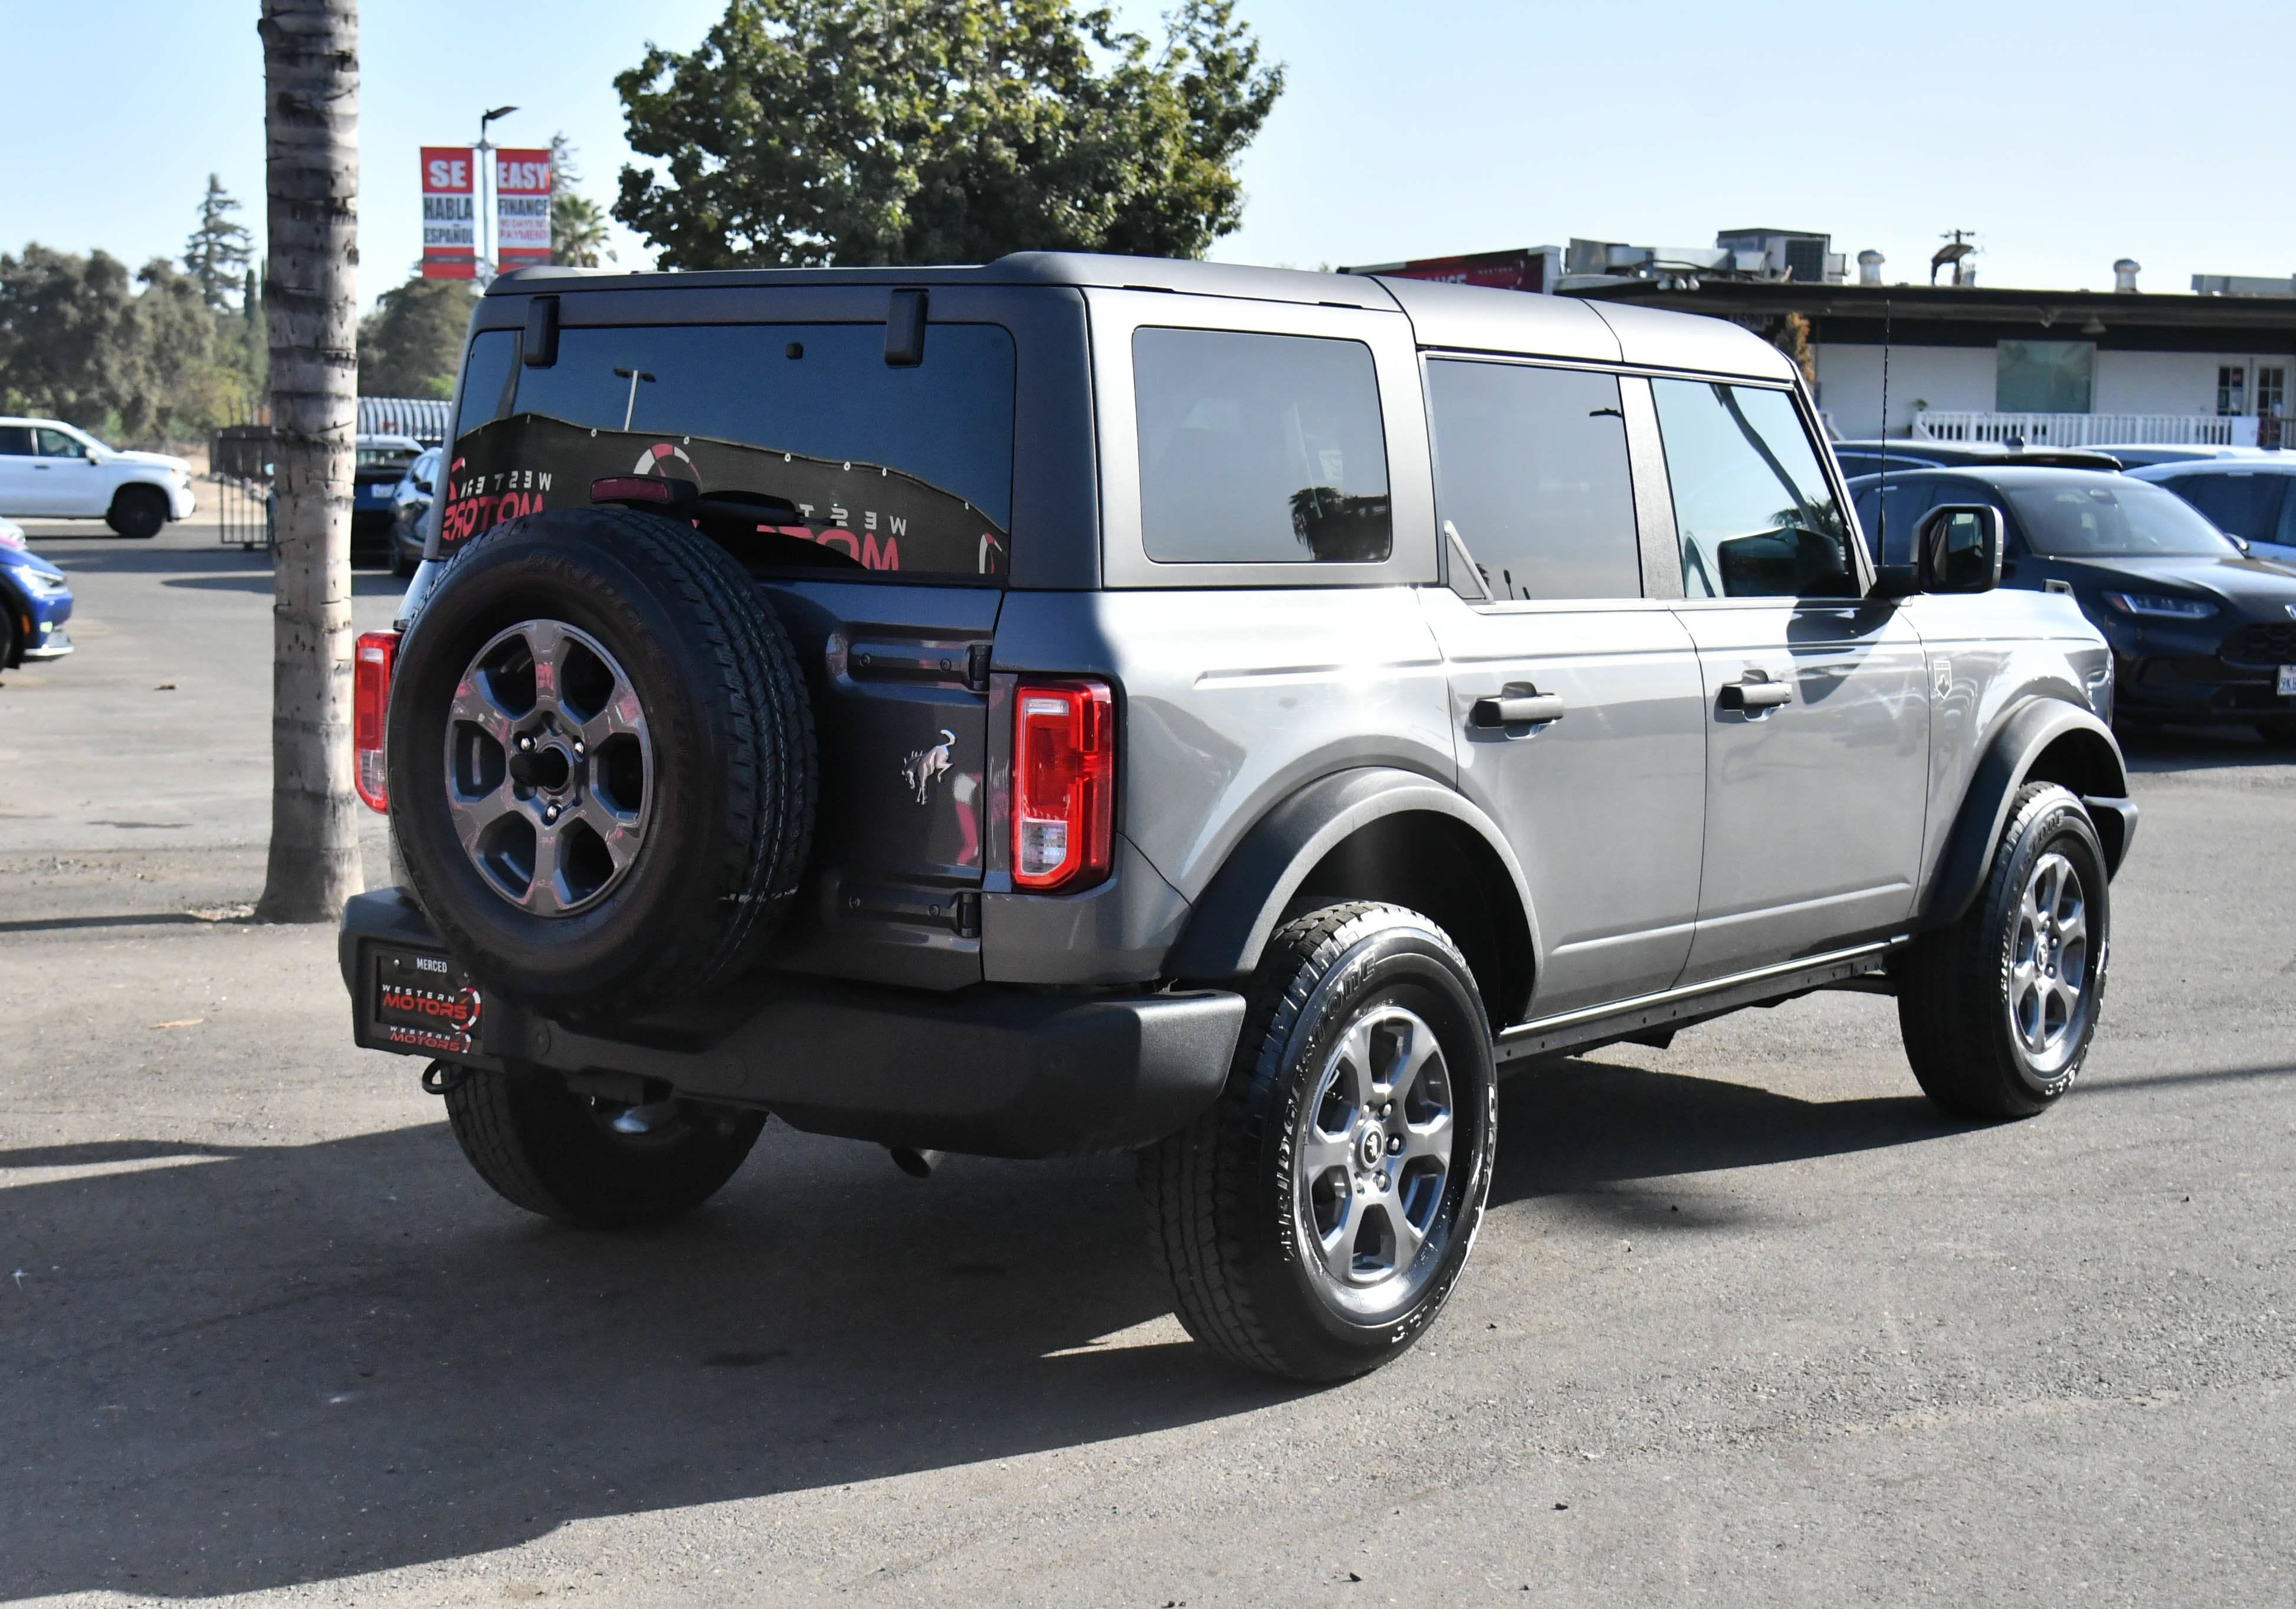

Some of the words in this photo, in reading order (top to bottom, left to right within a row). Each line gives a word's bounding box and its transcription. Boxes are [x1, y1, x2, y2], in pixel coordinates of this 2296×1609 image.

[429, 160, 467, 188] SE
[497, 162, 549, 189] EASY
[424, 198, 473, 221] HABLA
[424, 224, 473, 243] ESPAÑOL
[416, 958, 447, 973] MERCED
[382, 984, 455, 1002] WESTERN
[383, 992, 468, 1020] MOTORS
[390, 1026, 451, 1040] WESTERN
[390, 1033, 461, 1051] MOTORS
